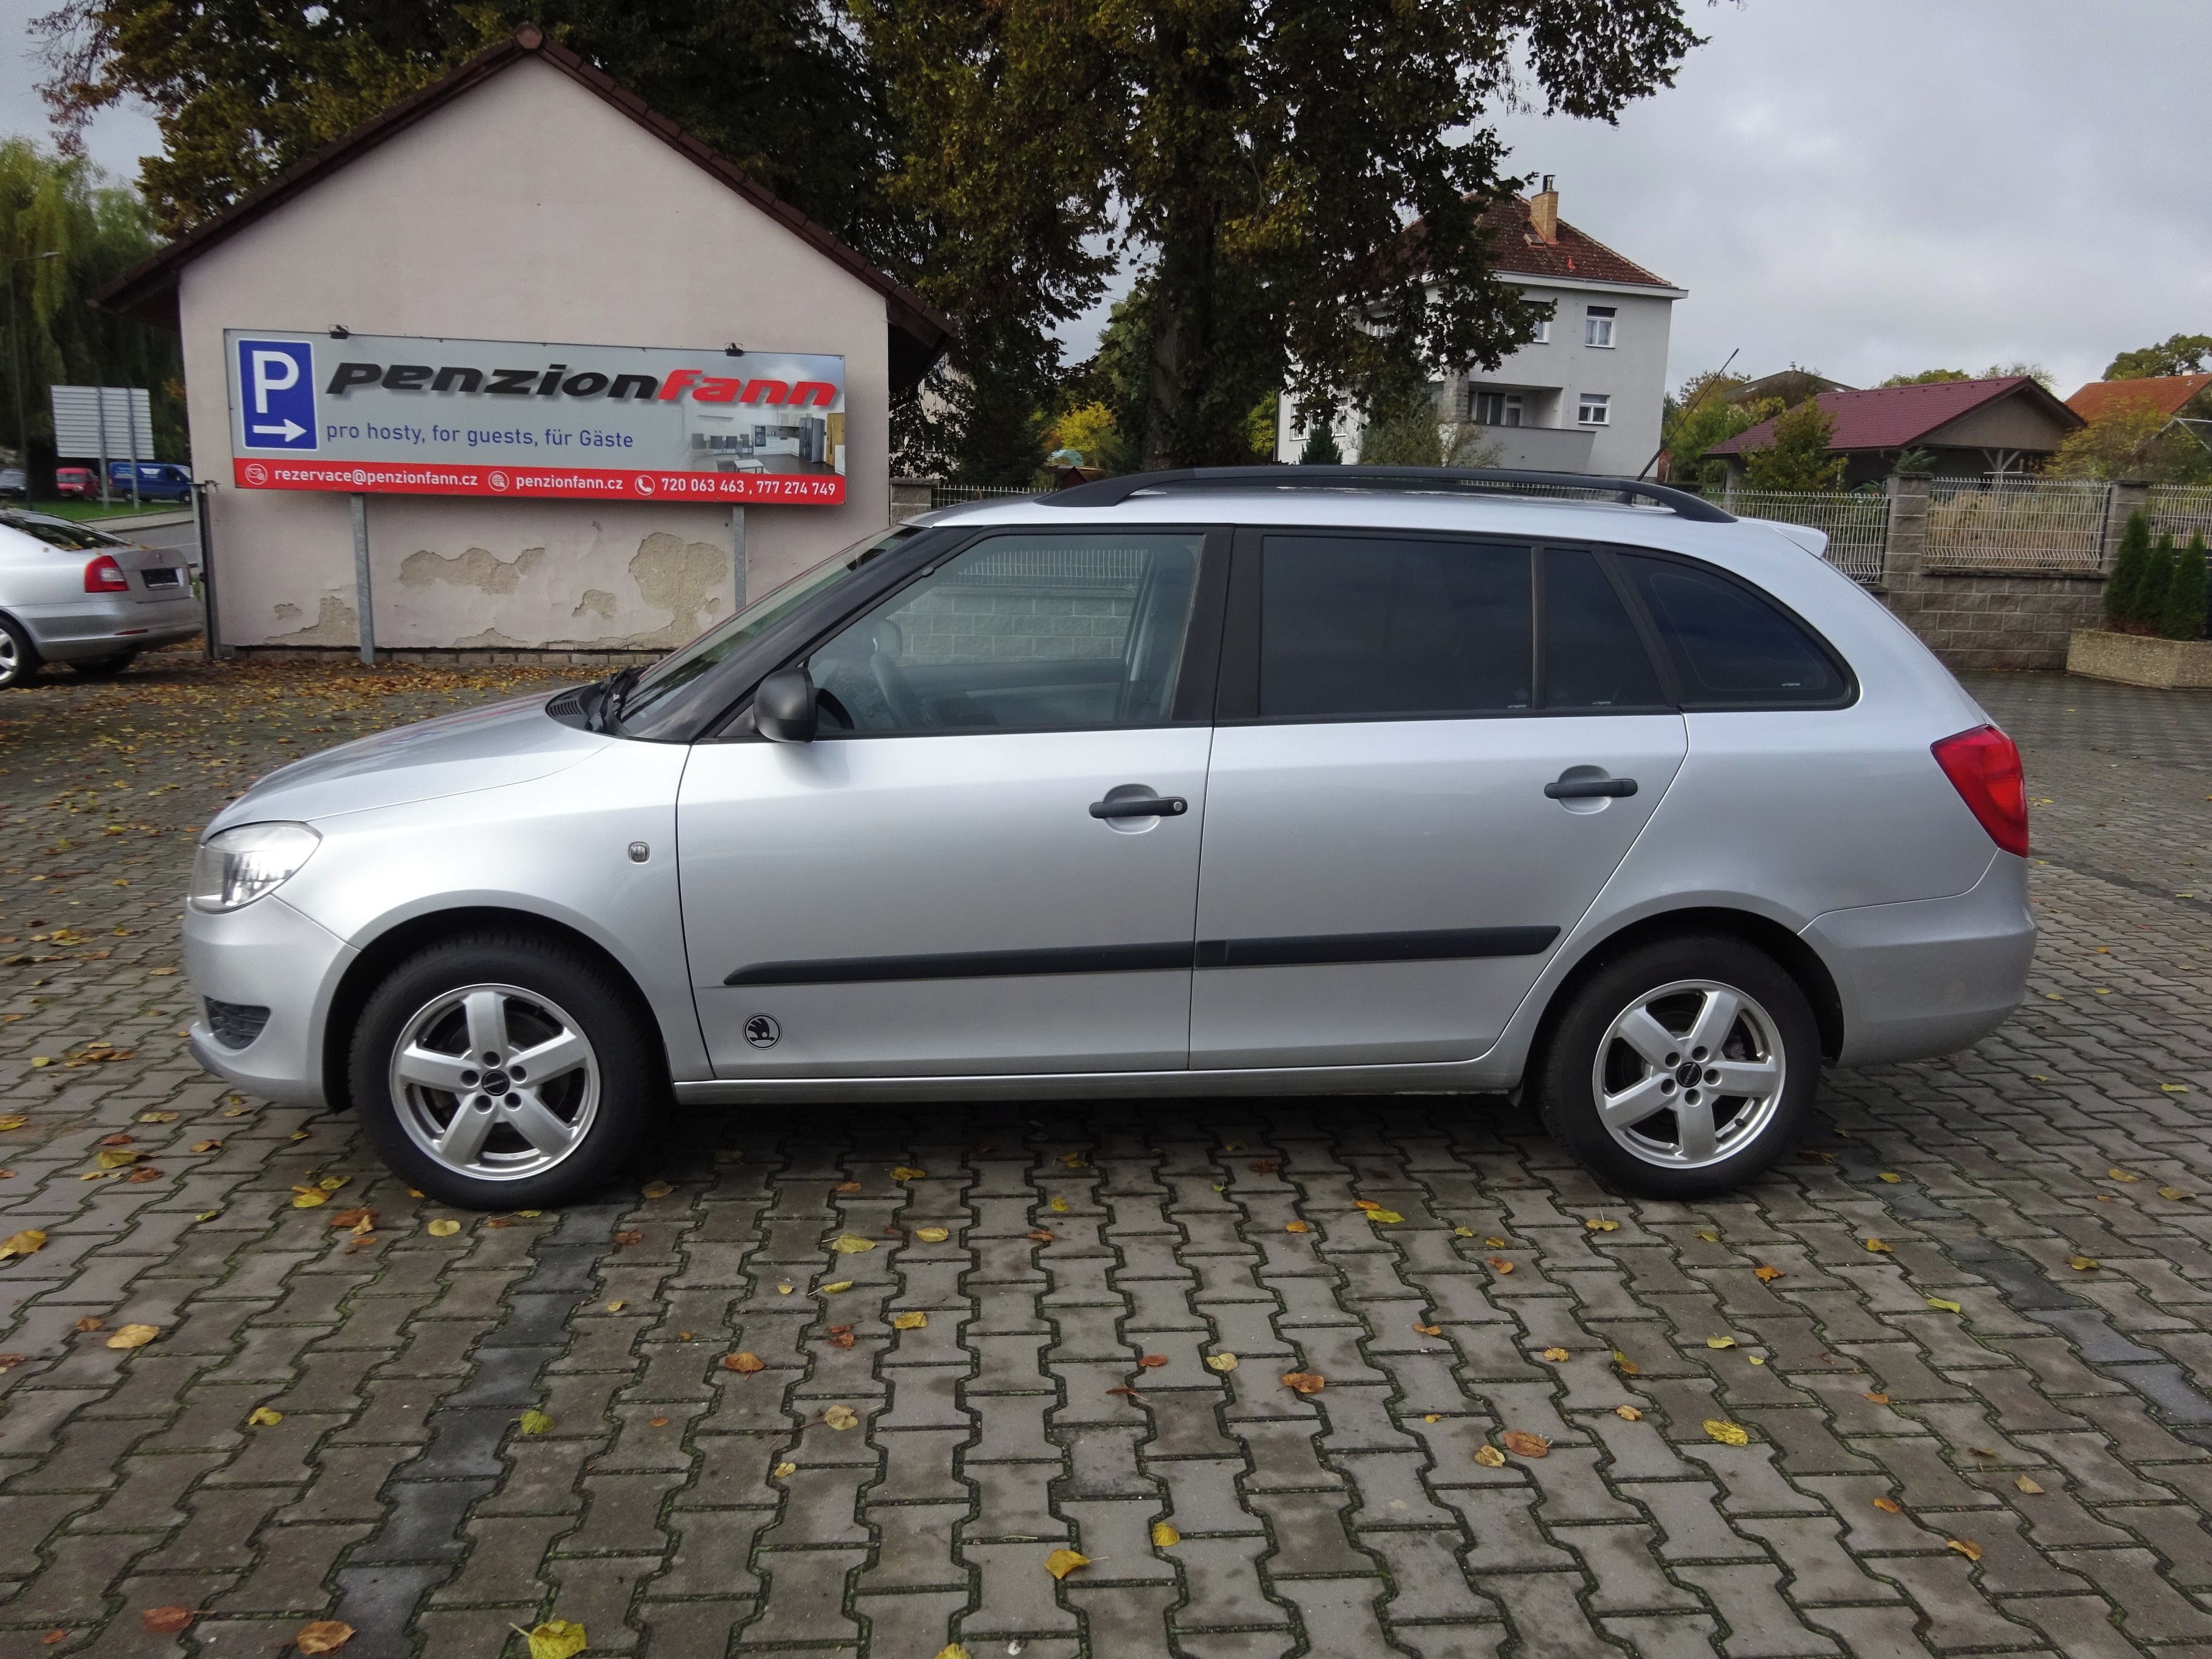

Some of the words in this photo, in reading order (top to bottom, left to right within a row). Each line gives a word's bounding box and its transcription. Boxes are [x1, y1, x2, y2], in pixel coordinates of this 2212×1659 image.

[252, 350, 300, 414] P
[326, 424, 360, 442] pro
[367, 422, 426, 444] hosty,
[432, 425, 460, 442] for
[467, 428, 538, 447] guests,
[545, 427, 572, 445] für
[580, 429, 634, 447] Gäste
[274, 468, 478, 486] rezervace@penzionfann.cz
[515, 474, 623, 490] penzionfann.cz
[662, 478, 686, 492] 720
[691, 479, 715, 492] 063
[756, 481, 779, 494] 777
[784, 481, 808, 495] 274
[811, 482, 836, 496] 749
